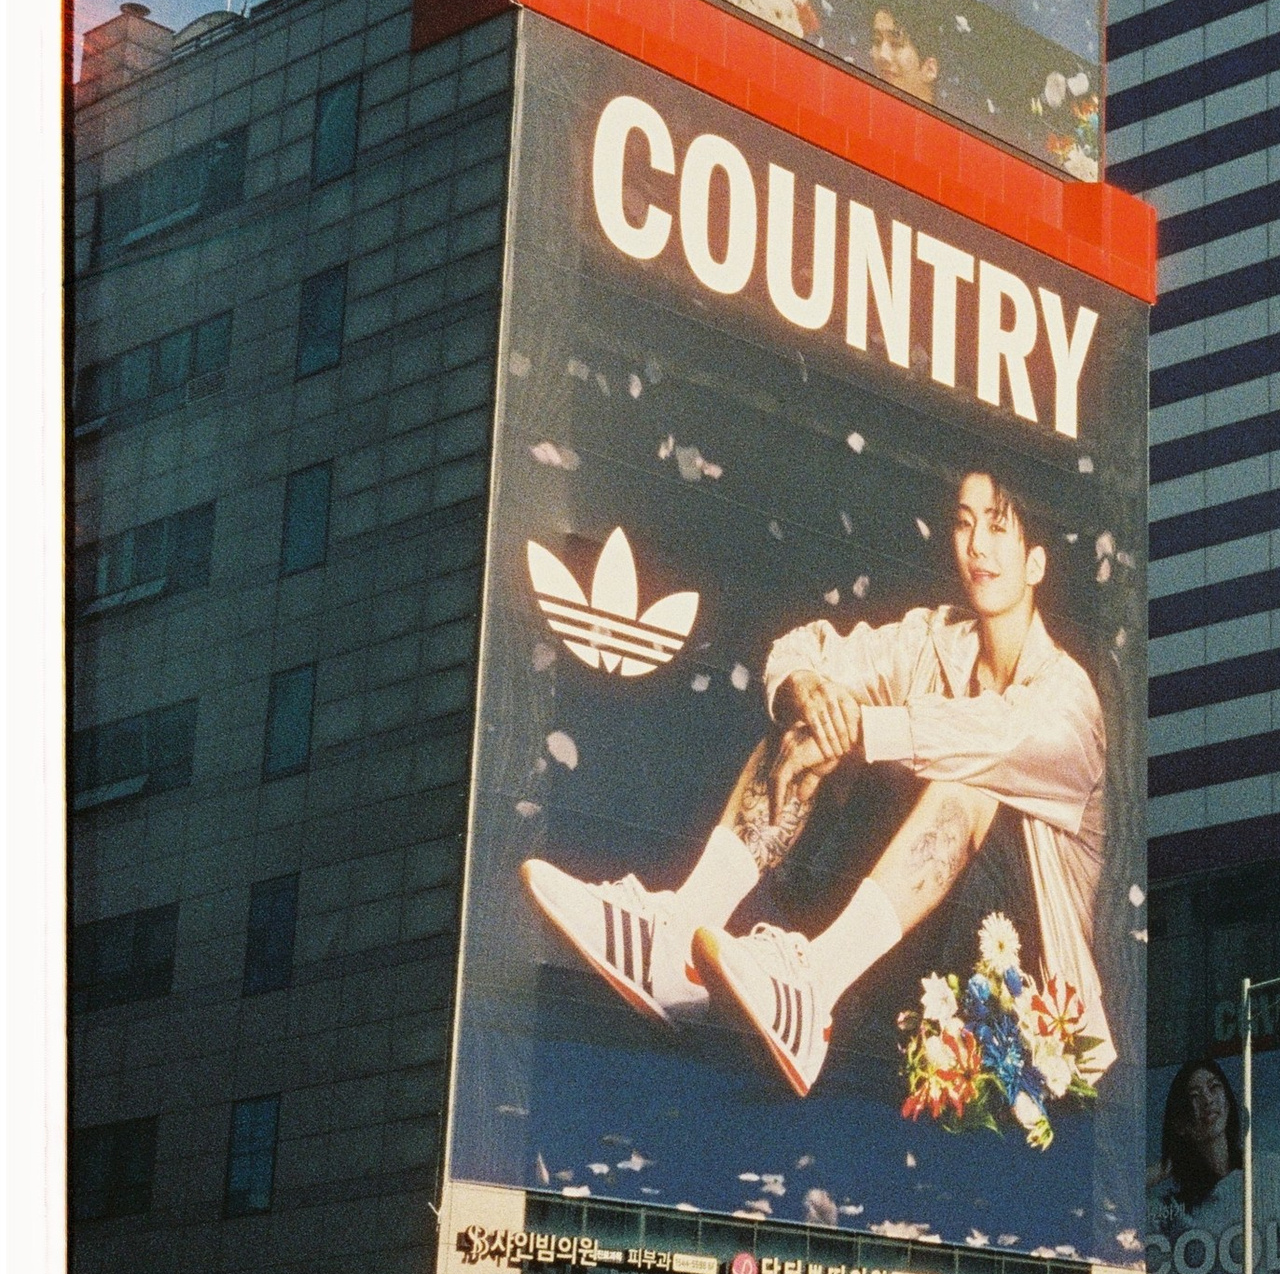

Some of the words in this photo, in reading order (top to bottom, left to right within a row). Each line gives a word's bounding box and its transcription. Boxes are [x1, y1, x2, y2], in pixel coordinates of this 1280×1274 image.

[592, 95, 1098, 440] COUNTRY
[490, 1230, 598, 1267] 샤인빔의원
[627, 1248, 672, 1271] 피부과
